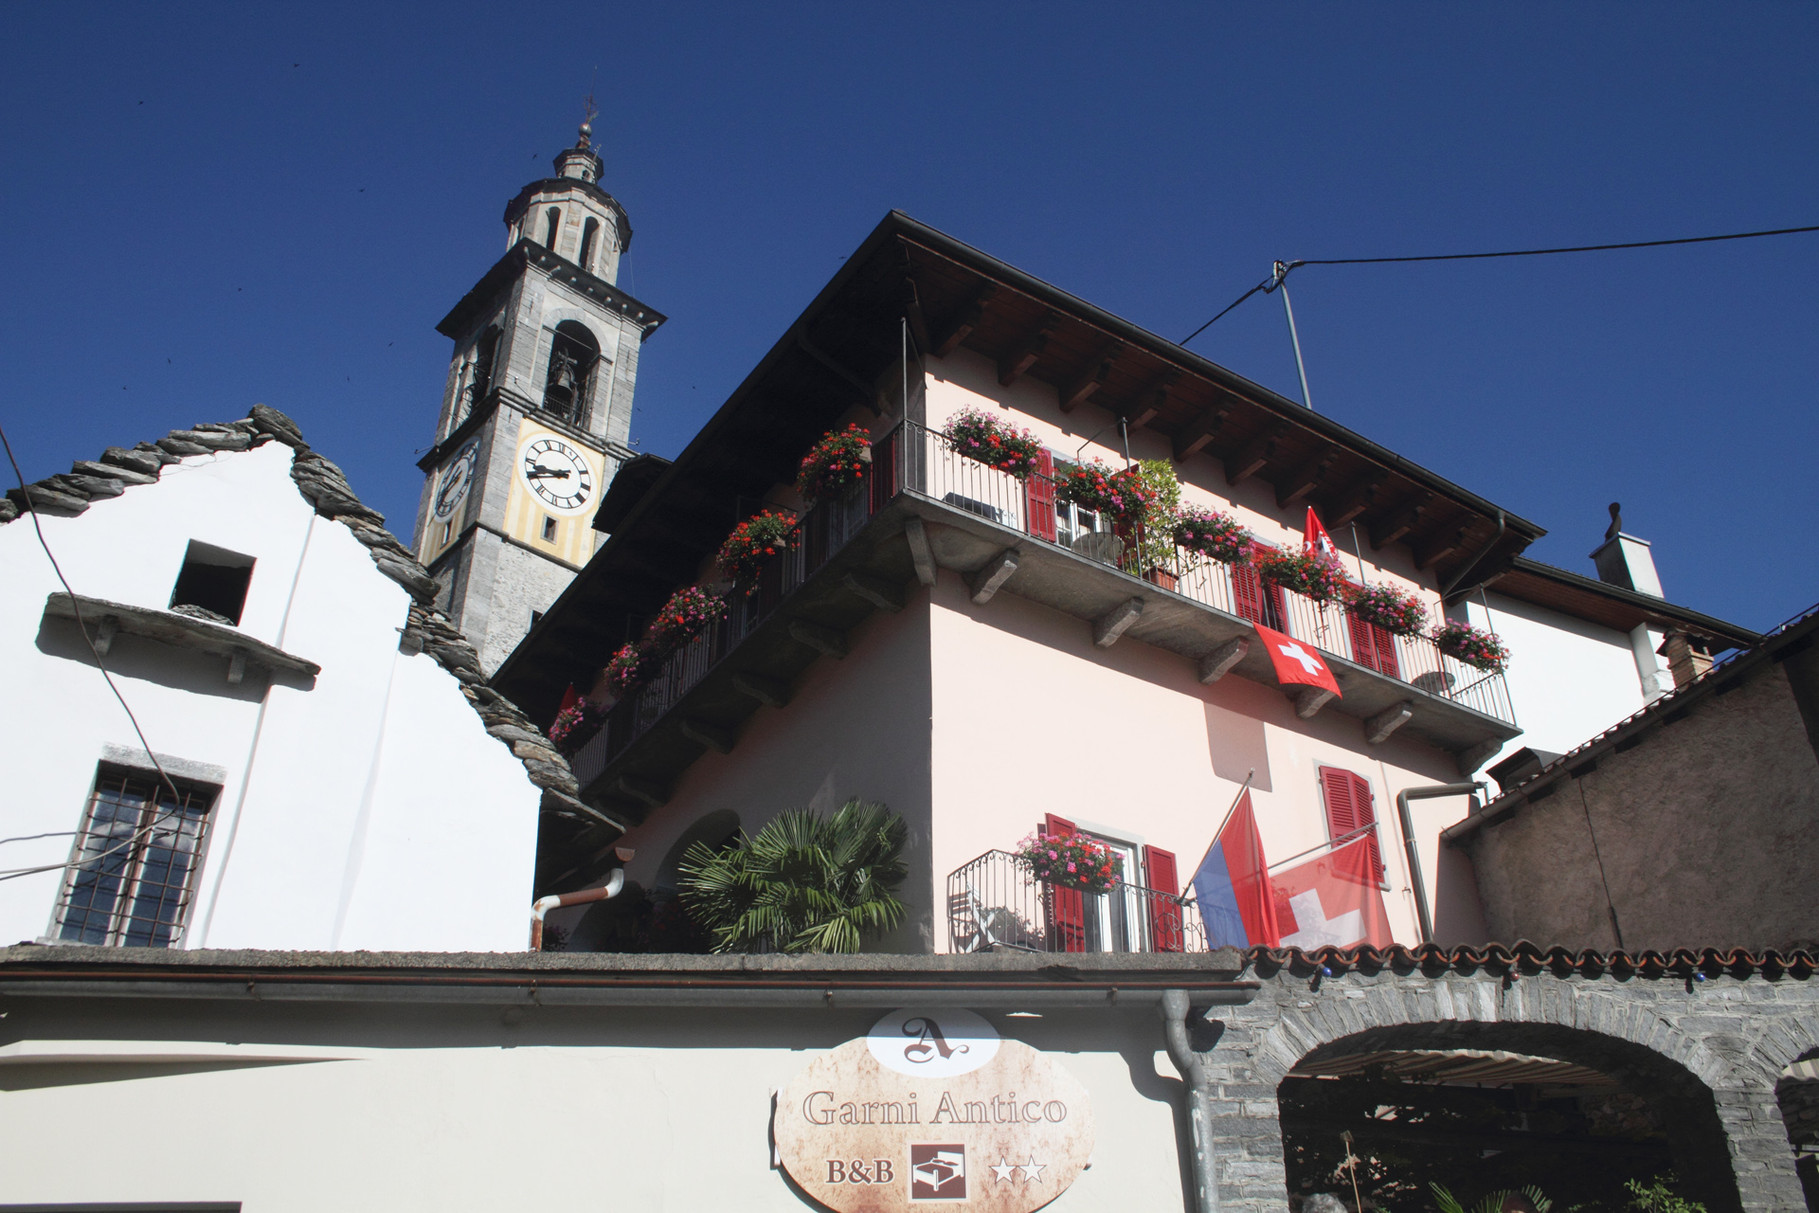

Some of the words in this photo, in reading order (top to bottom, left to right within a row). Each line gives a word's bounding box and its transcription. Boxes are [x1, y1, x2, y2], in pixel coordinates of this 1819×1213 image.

[901, 1016, 970, 1064] A
[802, 1090, 921, 1126] Garni
[929, 1090, 1068, 1125] Antico
[825, 1158, 895, 1185] B&B
